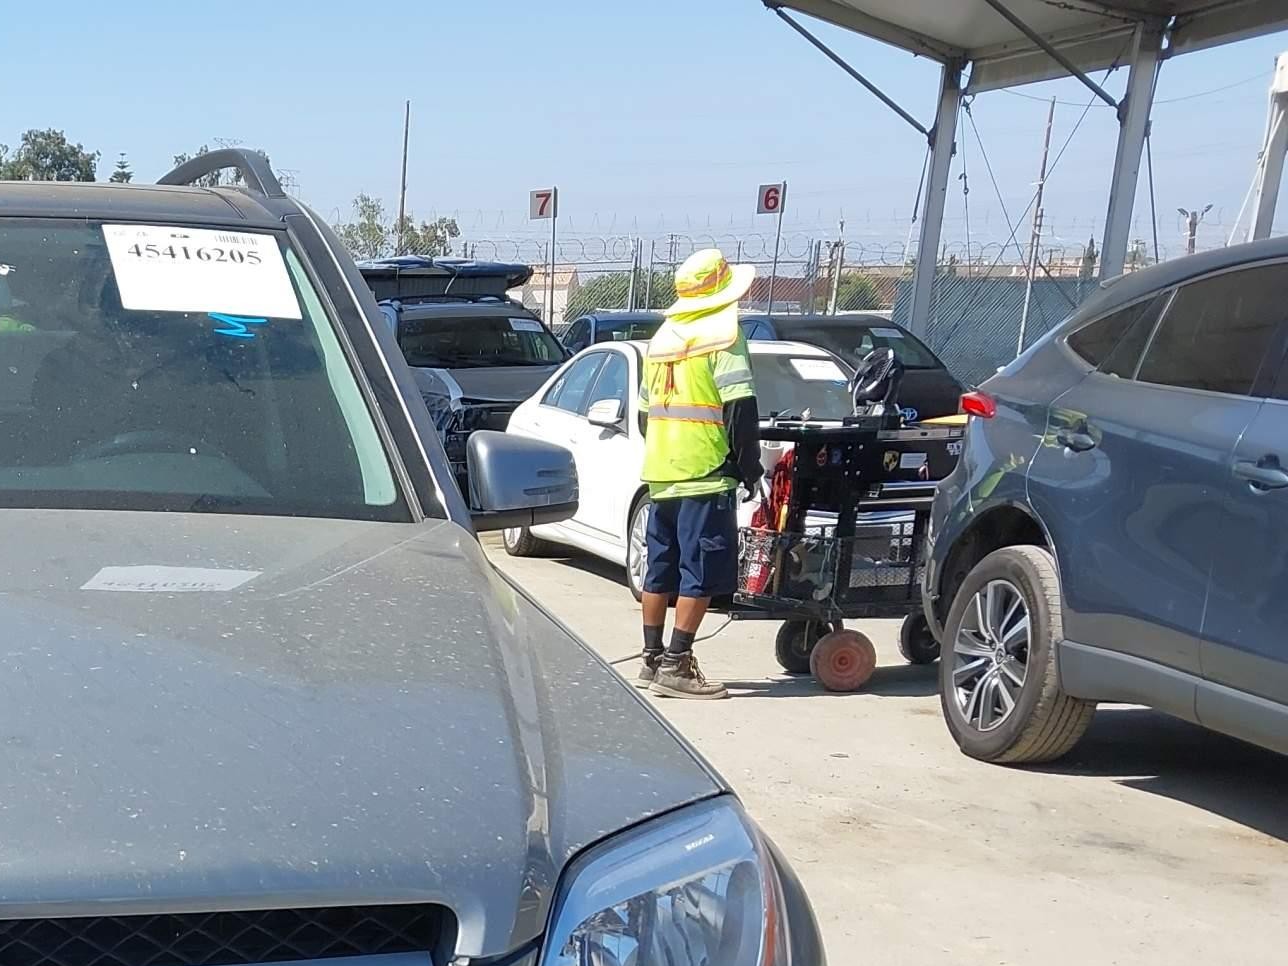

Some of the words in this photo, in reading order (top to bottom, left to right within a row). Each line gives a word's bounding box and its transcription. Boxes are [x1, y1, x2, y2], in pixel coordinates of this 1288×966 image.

[535, 192, 552, 216] 7
[763, 187, 780, 210] 6
[127, 243, 263, 265] 45416205
